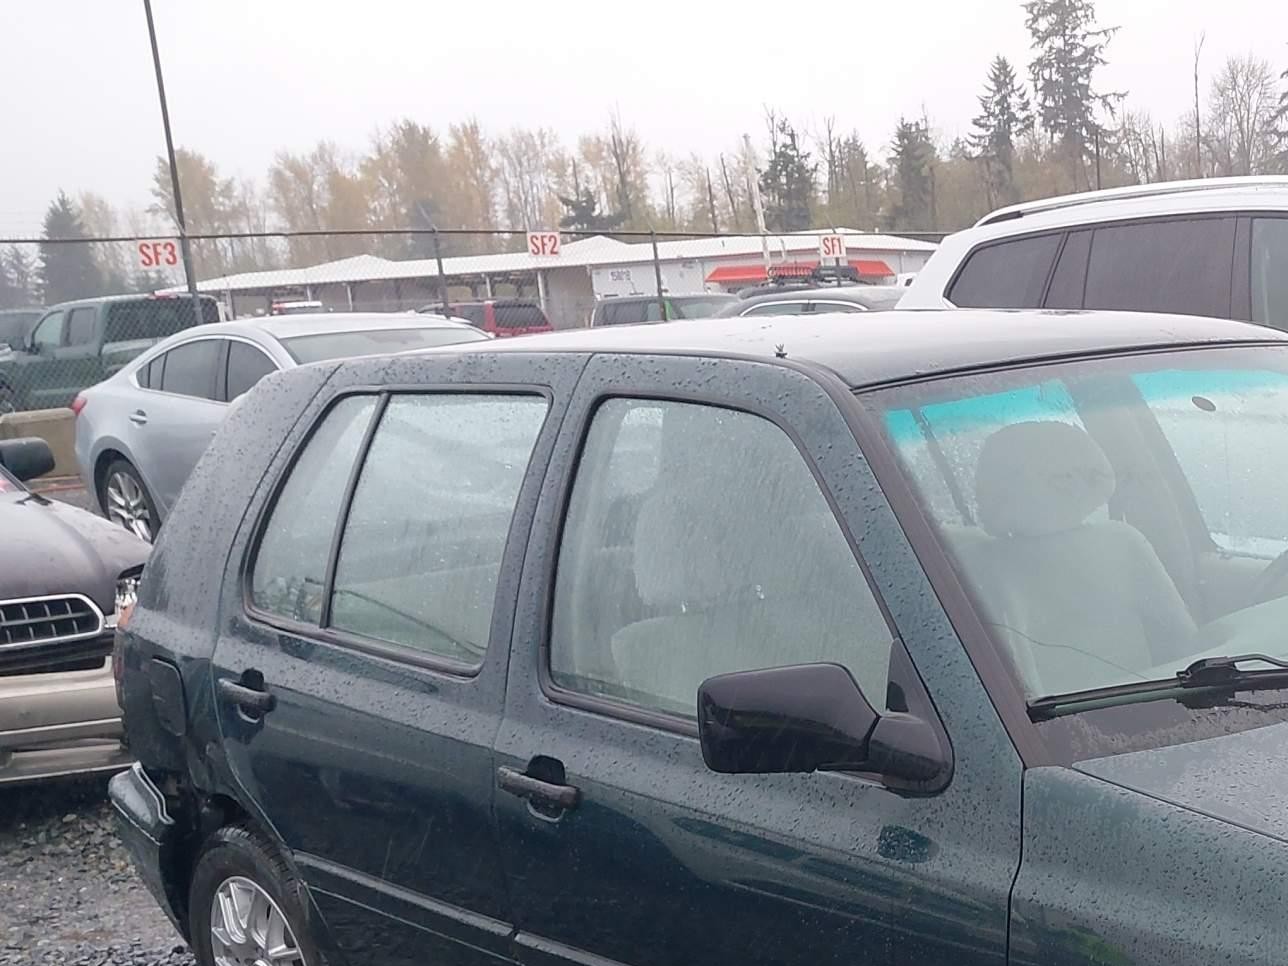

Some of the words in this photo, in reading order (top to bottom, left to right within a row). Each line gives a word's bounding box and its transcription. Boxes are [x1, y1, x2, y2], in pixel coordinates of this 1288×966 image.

[139, 242, 177, 266] SF3
[530, 234, 559, 255] SF2
[822, 236, 842, 256] SF1
